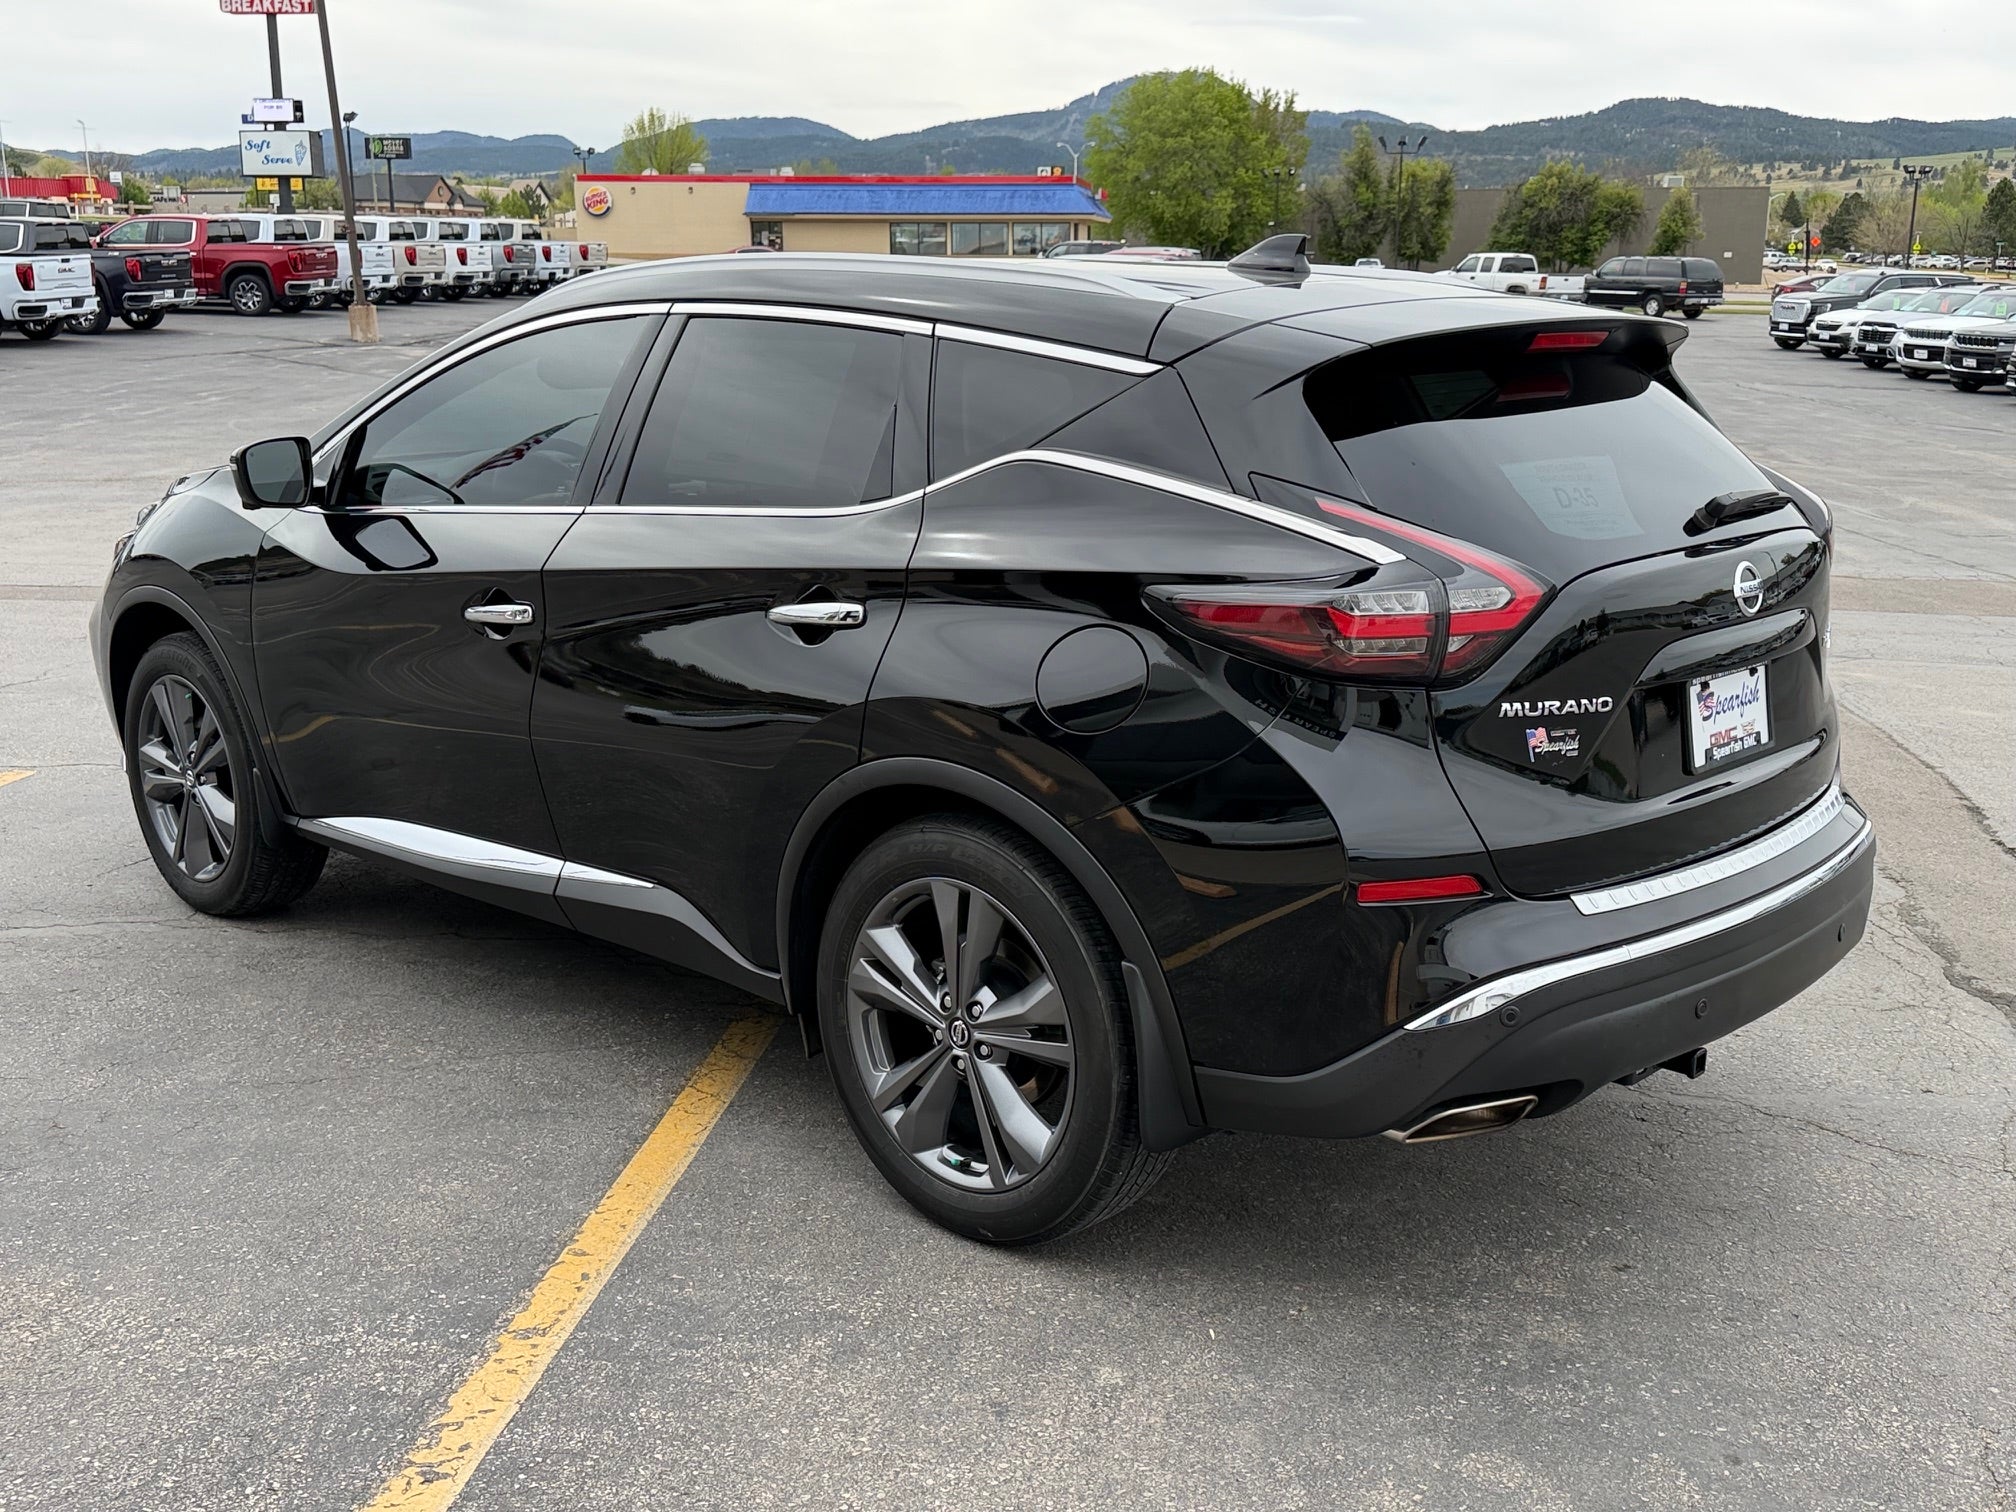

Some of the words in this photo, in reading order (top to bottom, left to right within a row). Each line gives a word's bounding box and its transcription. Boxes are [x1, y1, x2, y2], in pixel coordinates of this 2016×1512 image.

[221, 0, 311, 12] BREAKFAST
[245, 139, 271, 153] Soft
[262, 155, 294, 165] Serve
[586, 191, 607, 203] BURGER
[586, 196, 608, 210] KING
[1499, 697, 1613, 718] MURANO
[1702, 675, 1760, 725] Spearfish
[1535, 734, 1580, 755] Spearfish
[1710, 725, 1738, 748] GMC
[1713, 741, 1743, 761] Spearfish
[1743, 734, 1758, 749] GMC
